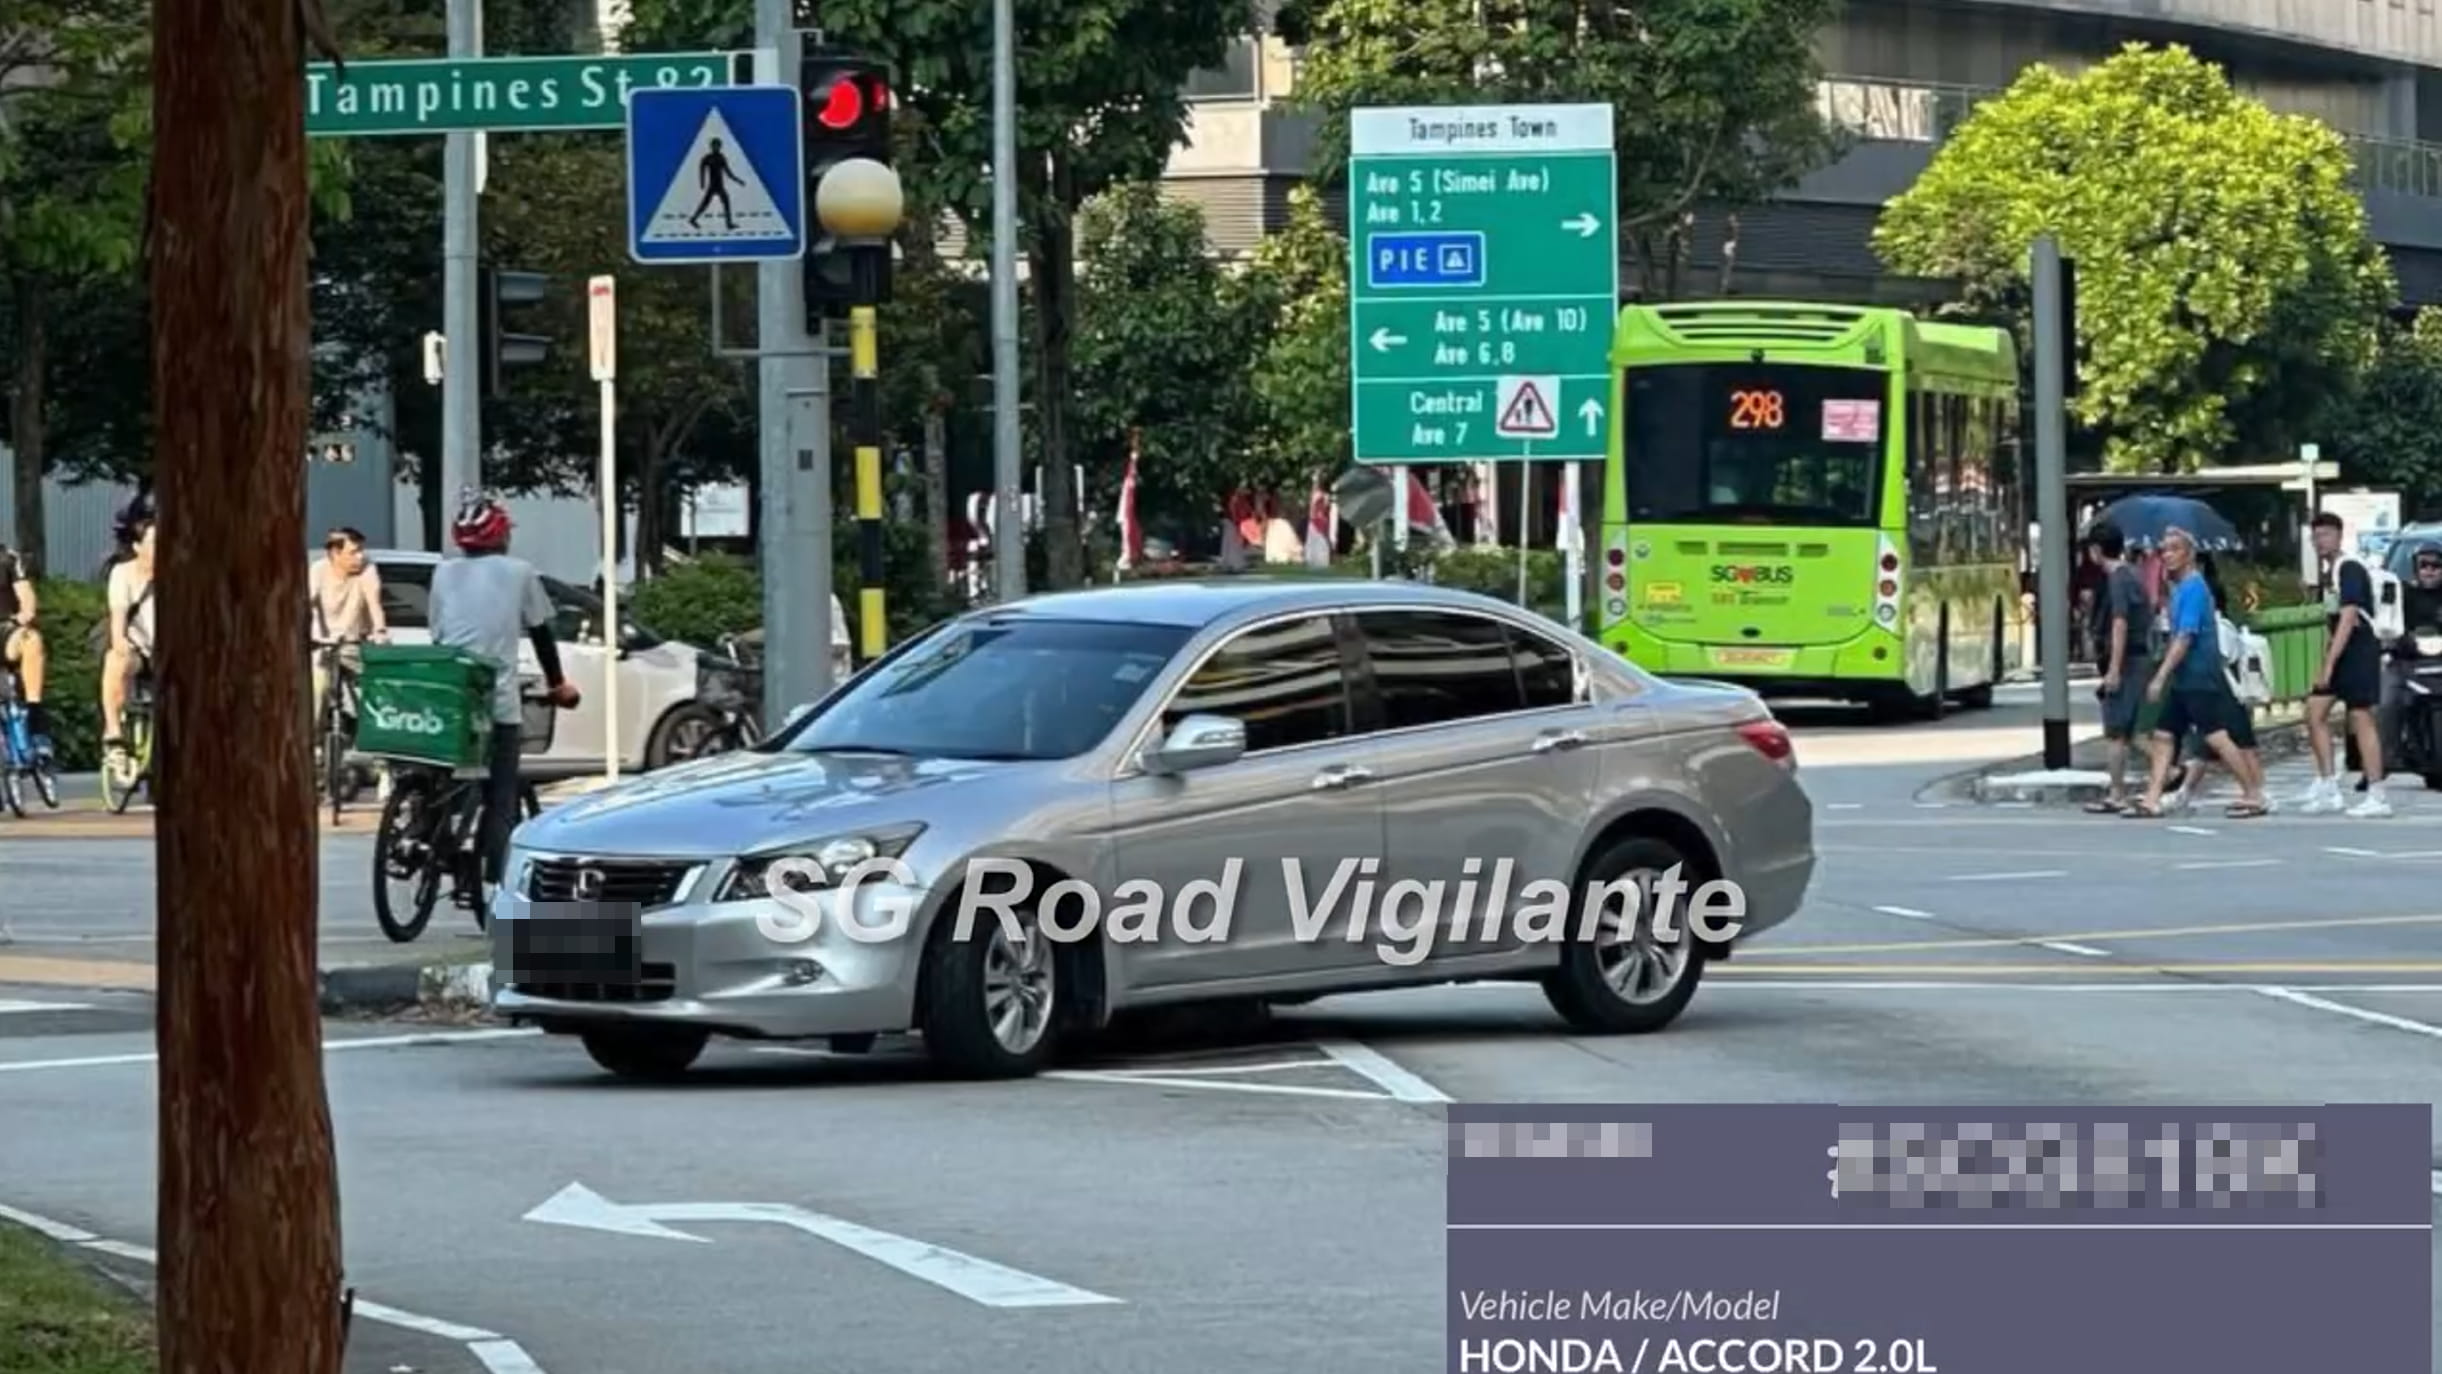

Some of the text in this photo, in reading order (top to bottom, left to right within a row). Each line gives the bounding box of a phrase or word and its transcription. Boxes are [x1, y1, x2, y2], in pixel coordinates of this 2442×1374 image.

[305, 70, 559, 122] Tampines
[580, 65, 632, 108] St
[1409, 115, 1558, 143] Tampines Town
[1366, 165, 1550, 195] Ave 5 (Simei Ave)
[1366, 202, 1399, 224] Ave
[1379, 248, 1428, 271] PIE
[1434, 306, 1587, 333] Ave 5 (Ave 10)
[1434, 342, 1468, 365] Ave
[1410, 391, 1483, 414] Central
[1730, 391, 1784, 428] 298
[1411, 422, 1468, 446] Ave 7
[365, 696, 444, 734] Grab
